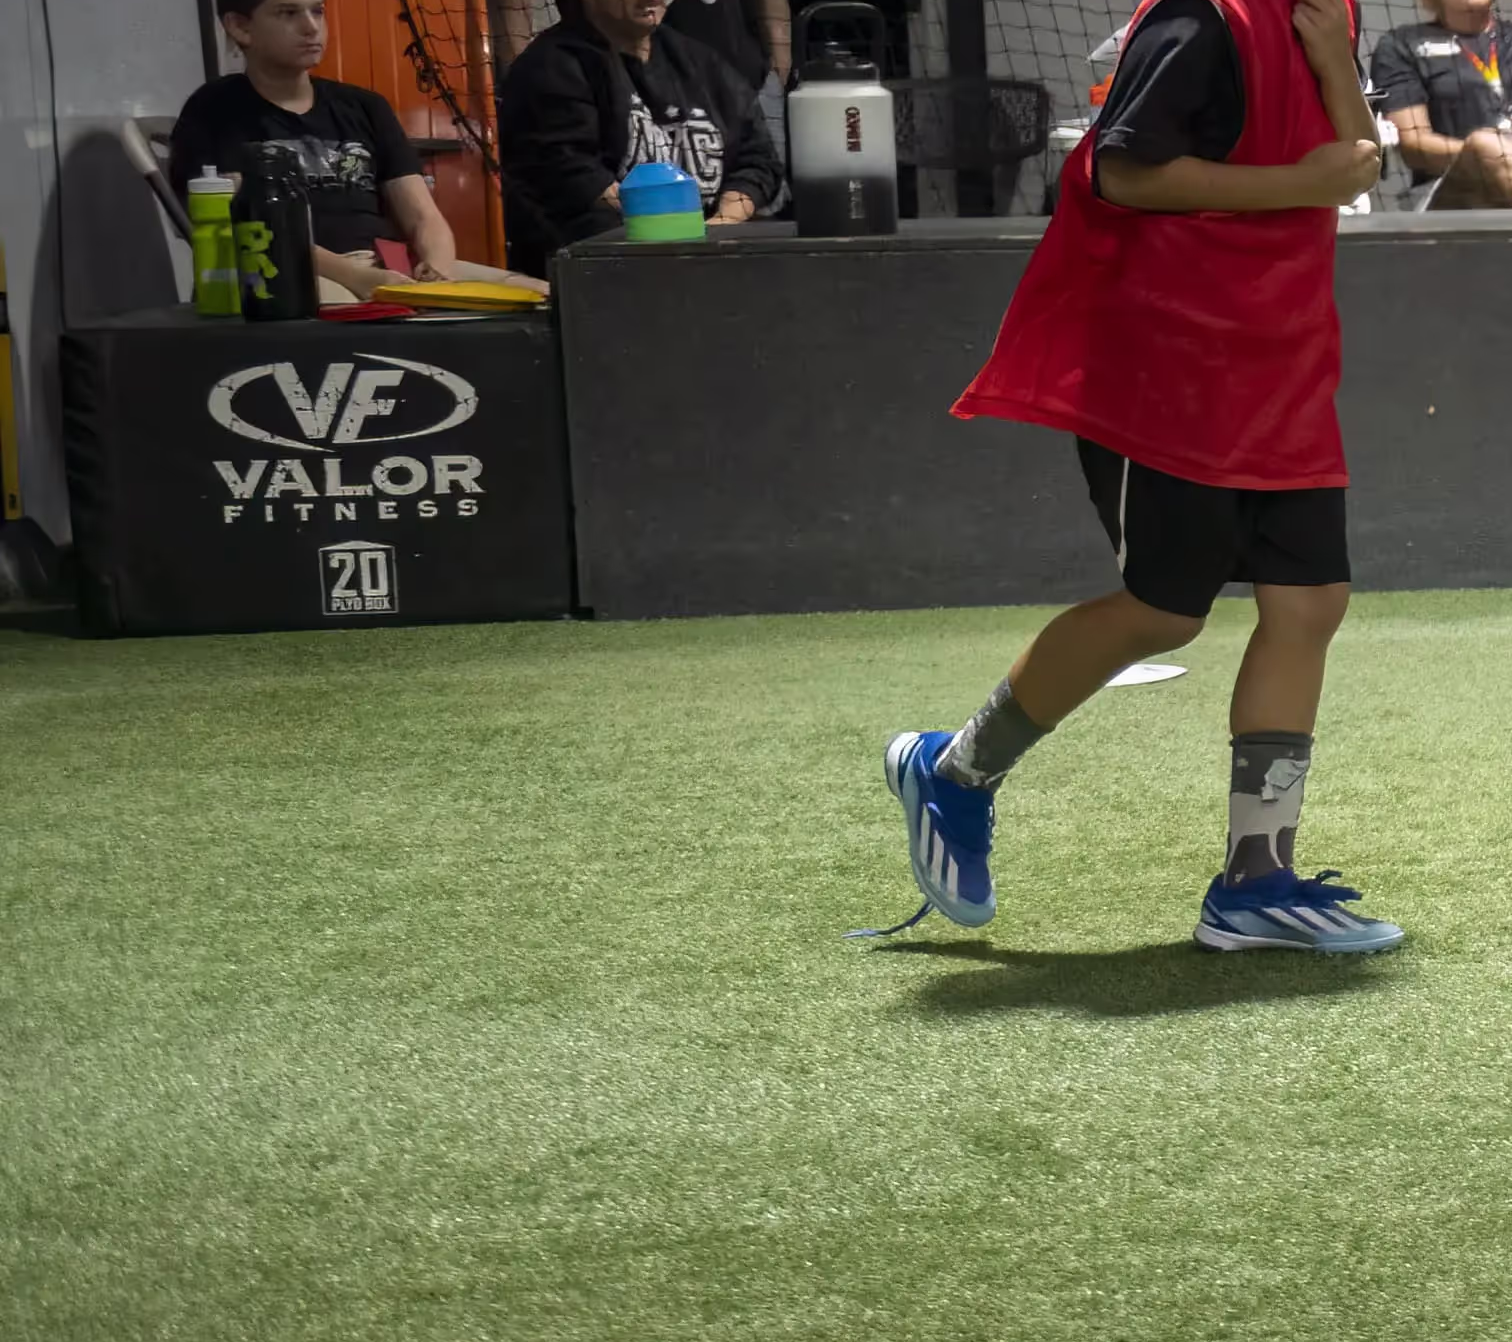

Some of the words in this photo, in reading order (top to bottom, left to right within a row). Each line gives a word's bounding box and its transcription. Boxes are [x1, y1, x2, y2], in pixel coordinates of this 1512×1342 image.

[273, 362, 405, 444] VF
[212, 455, 487, 499] VALOR
[223, 499, 480, 524] FITNESS
[328, 551, 389, 597] 20
[364, 596, 393, 611] BOX
